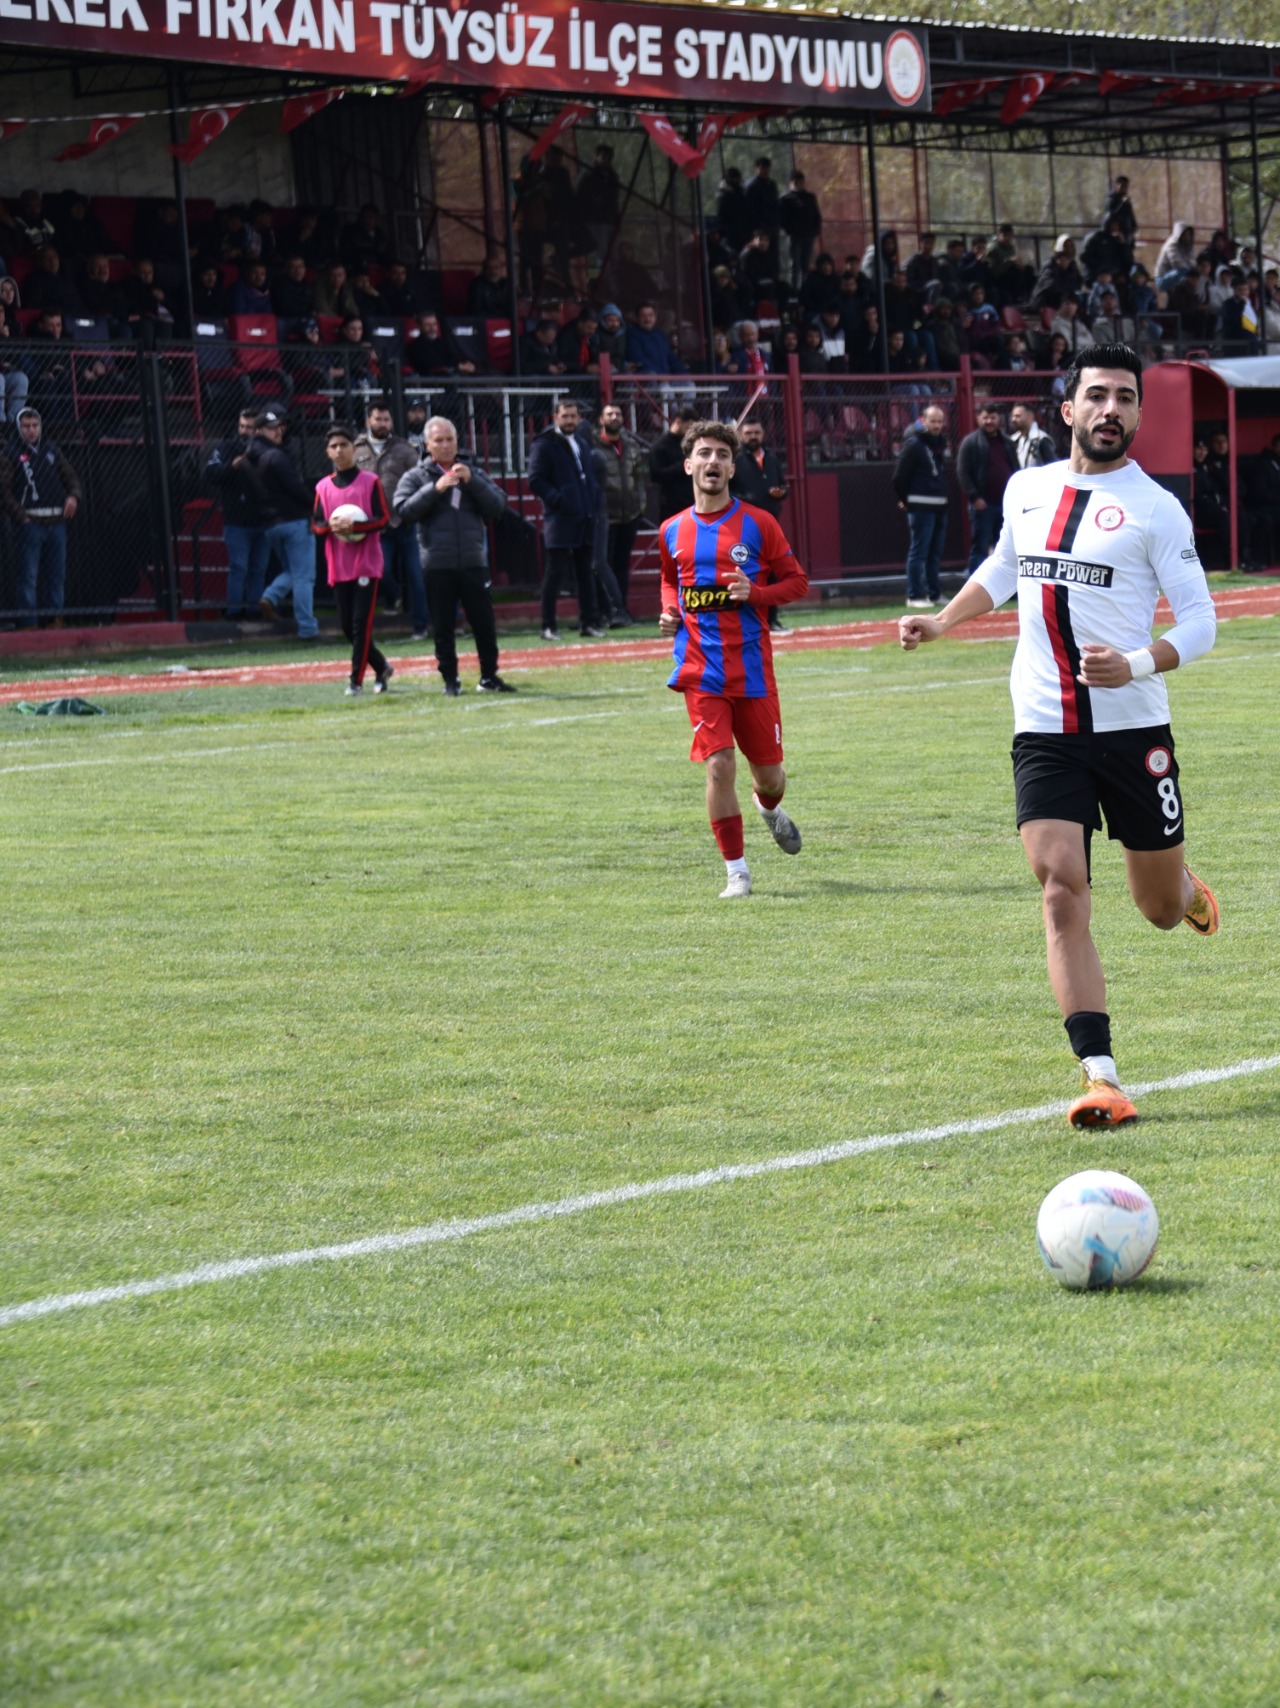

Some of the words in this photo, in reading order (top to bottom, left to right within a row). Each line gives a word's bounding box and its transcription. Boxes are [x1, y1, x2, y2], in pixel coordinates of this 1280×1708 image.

[369, 0, 556, 68] TÜYSÜZ
[568, 8, 663, 87] İLÇE
[673, 28, 883, 90] STADYUMU
[1018, 557, 1051, 578] Green
[1055, 560, 1109, 586] Power
[1157, 777, 1179, 820] 8
